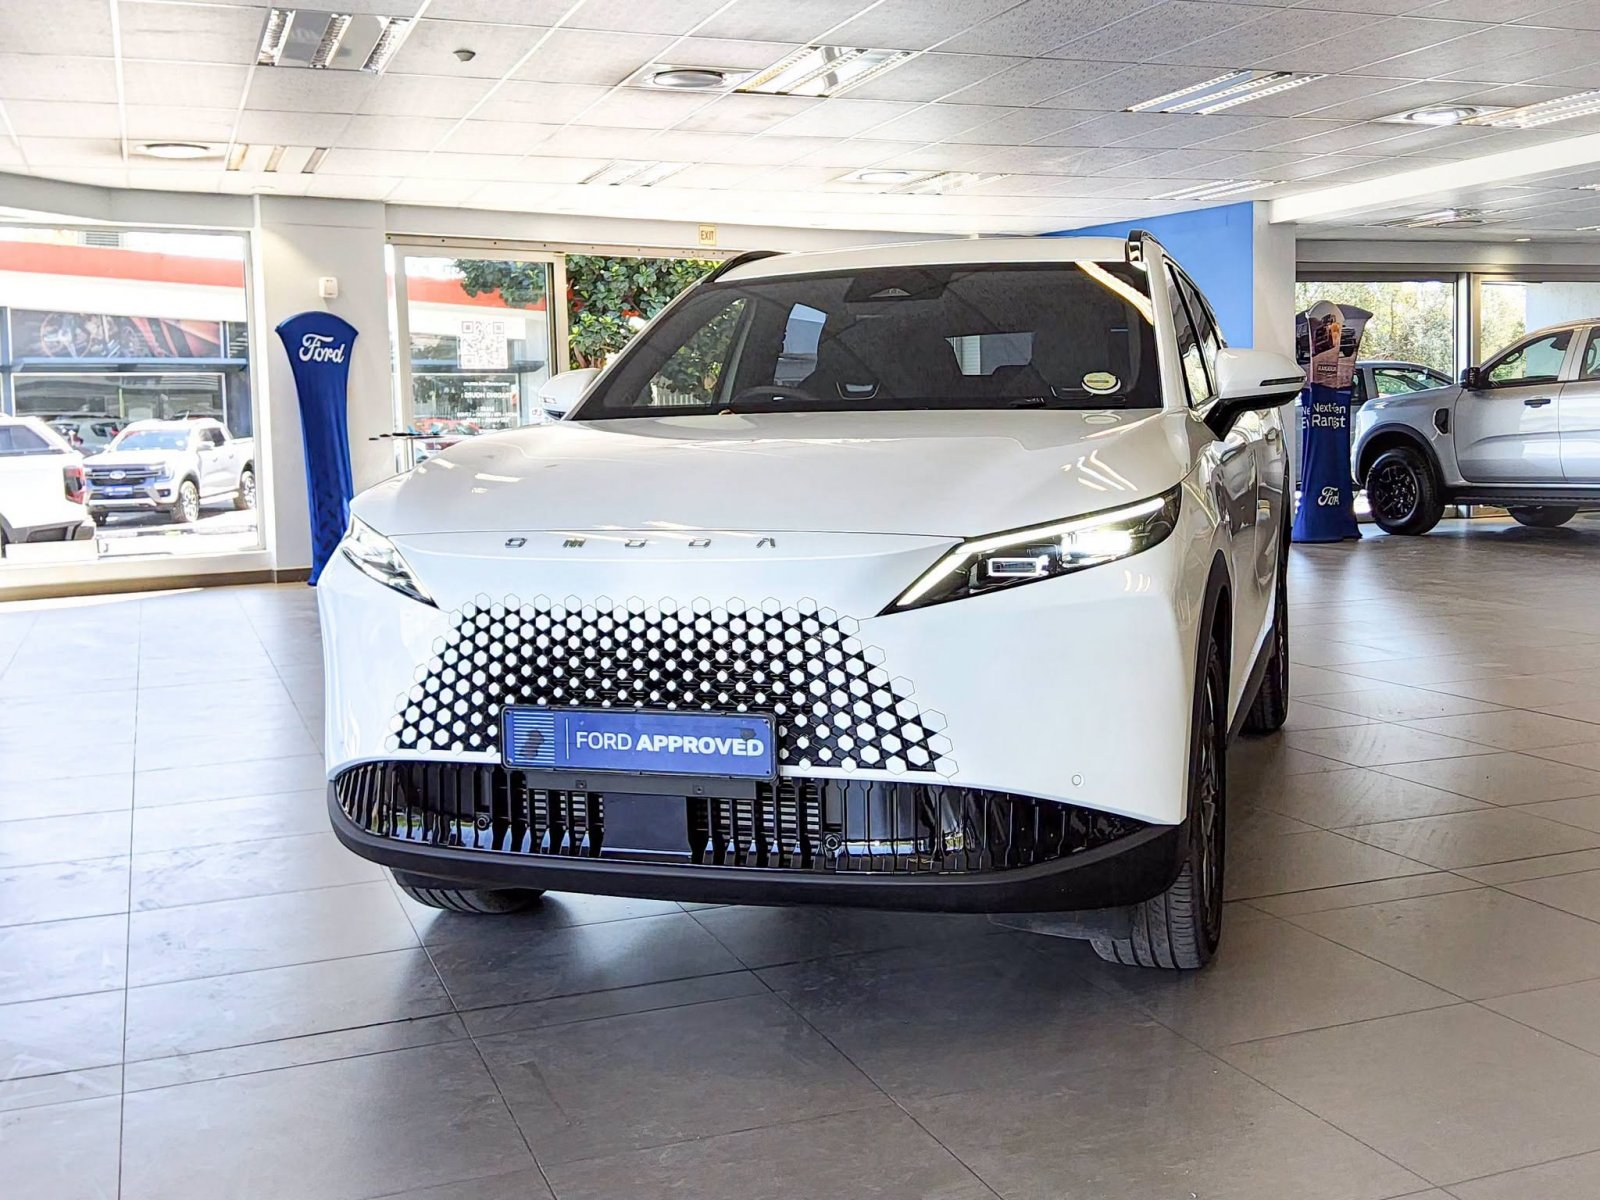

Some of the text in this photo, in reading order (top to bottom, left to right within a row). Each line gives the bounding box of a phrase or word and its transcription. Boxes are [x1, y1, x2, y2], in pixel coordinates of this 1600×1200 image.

[700, 230, 714, 241] EXIT
[298, 333, 346, 364] Ford
[575, 731, 765, 757] FORD APPROVED
